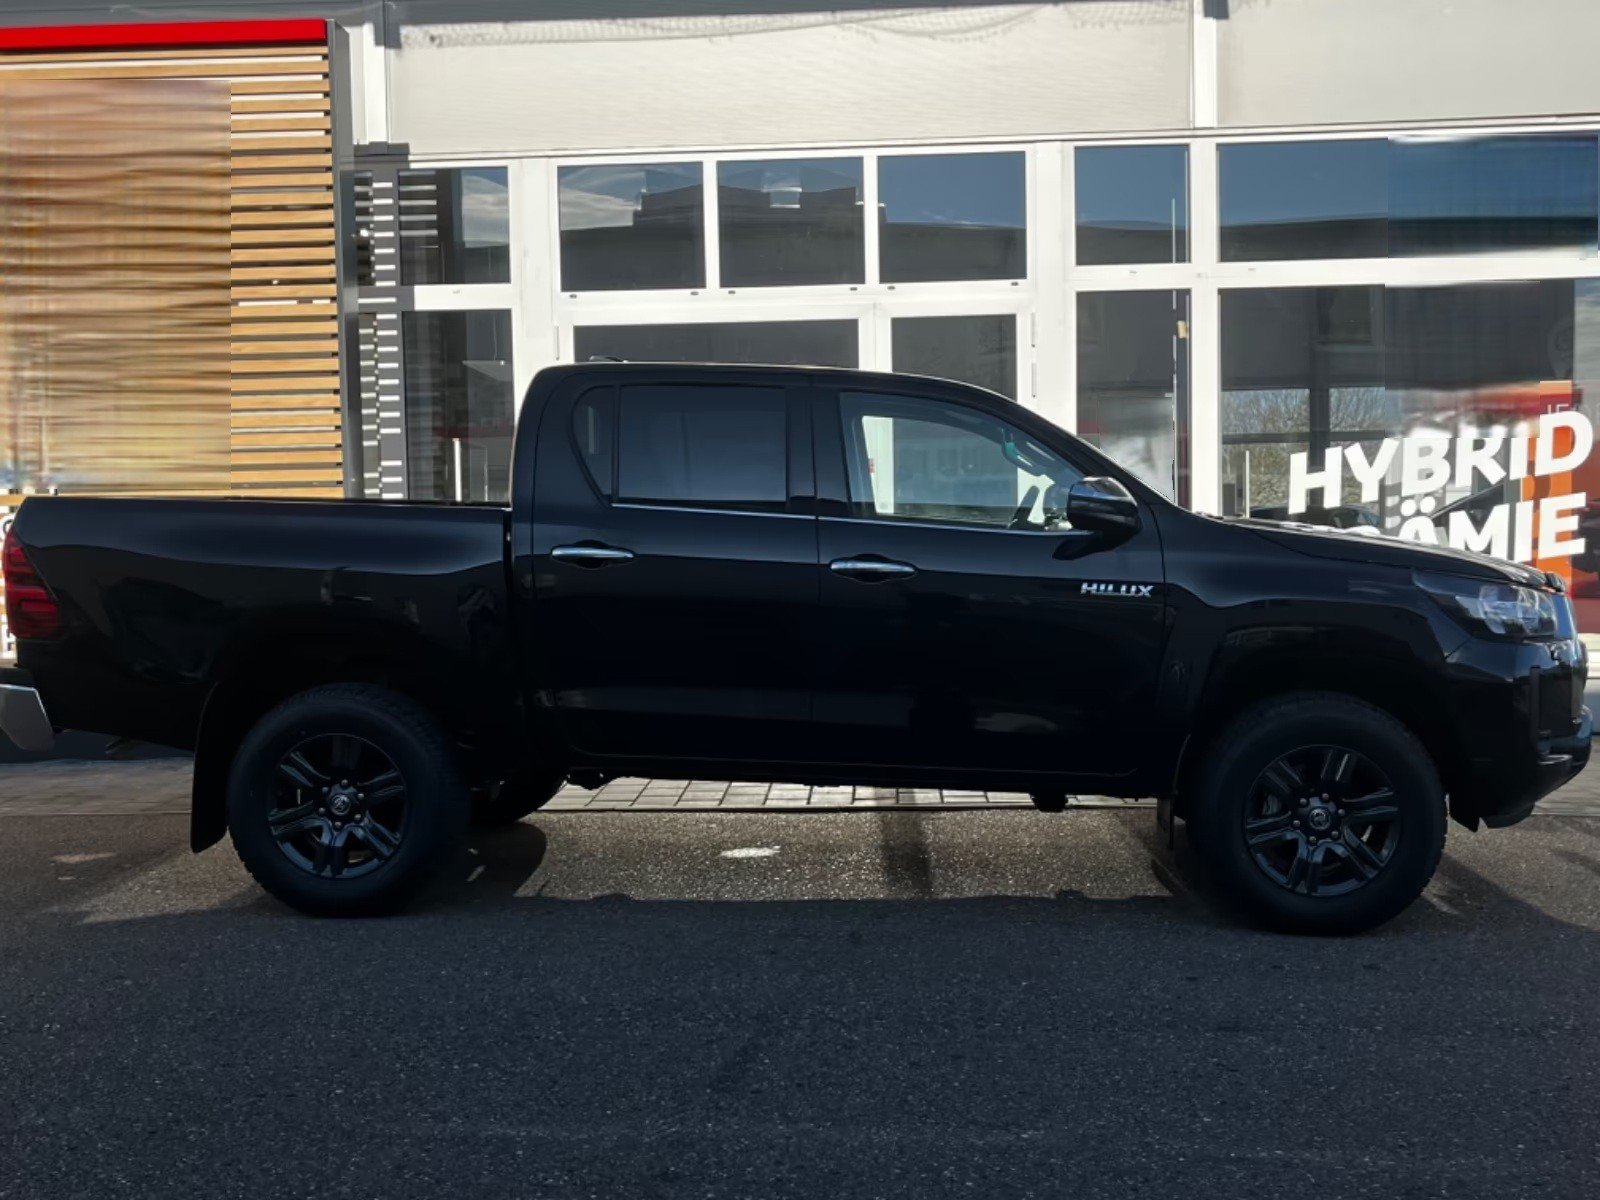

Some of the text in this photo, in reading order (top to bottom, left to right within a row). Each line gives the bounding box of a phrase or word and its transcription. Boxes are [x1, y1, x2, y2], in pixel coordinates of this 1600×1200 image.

[1289, 410, 1593, 514] HYBRID
[1347, 492, 1586, 563] ÄMIE
[1081, 582, 1154, 598] HILUX
